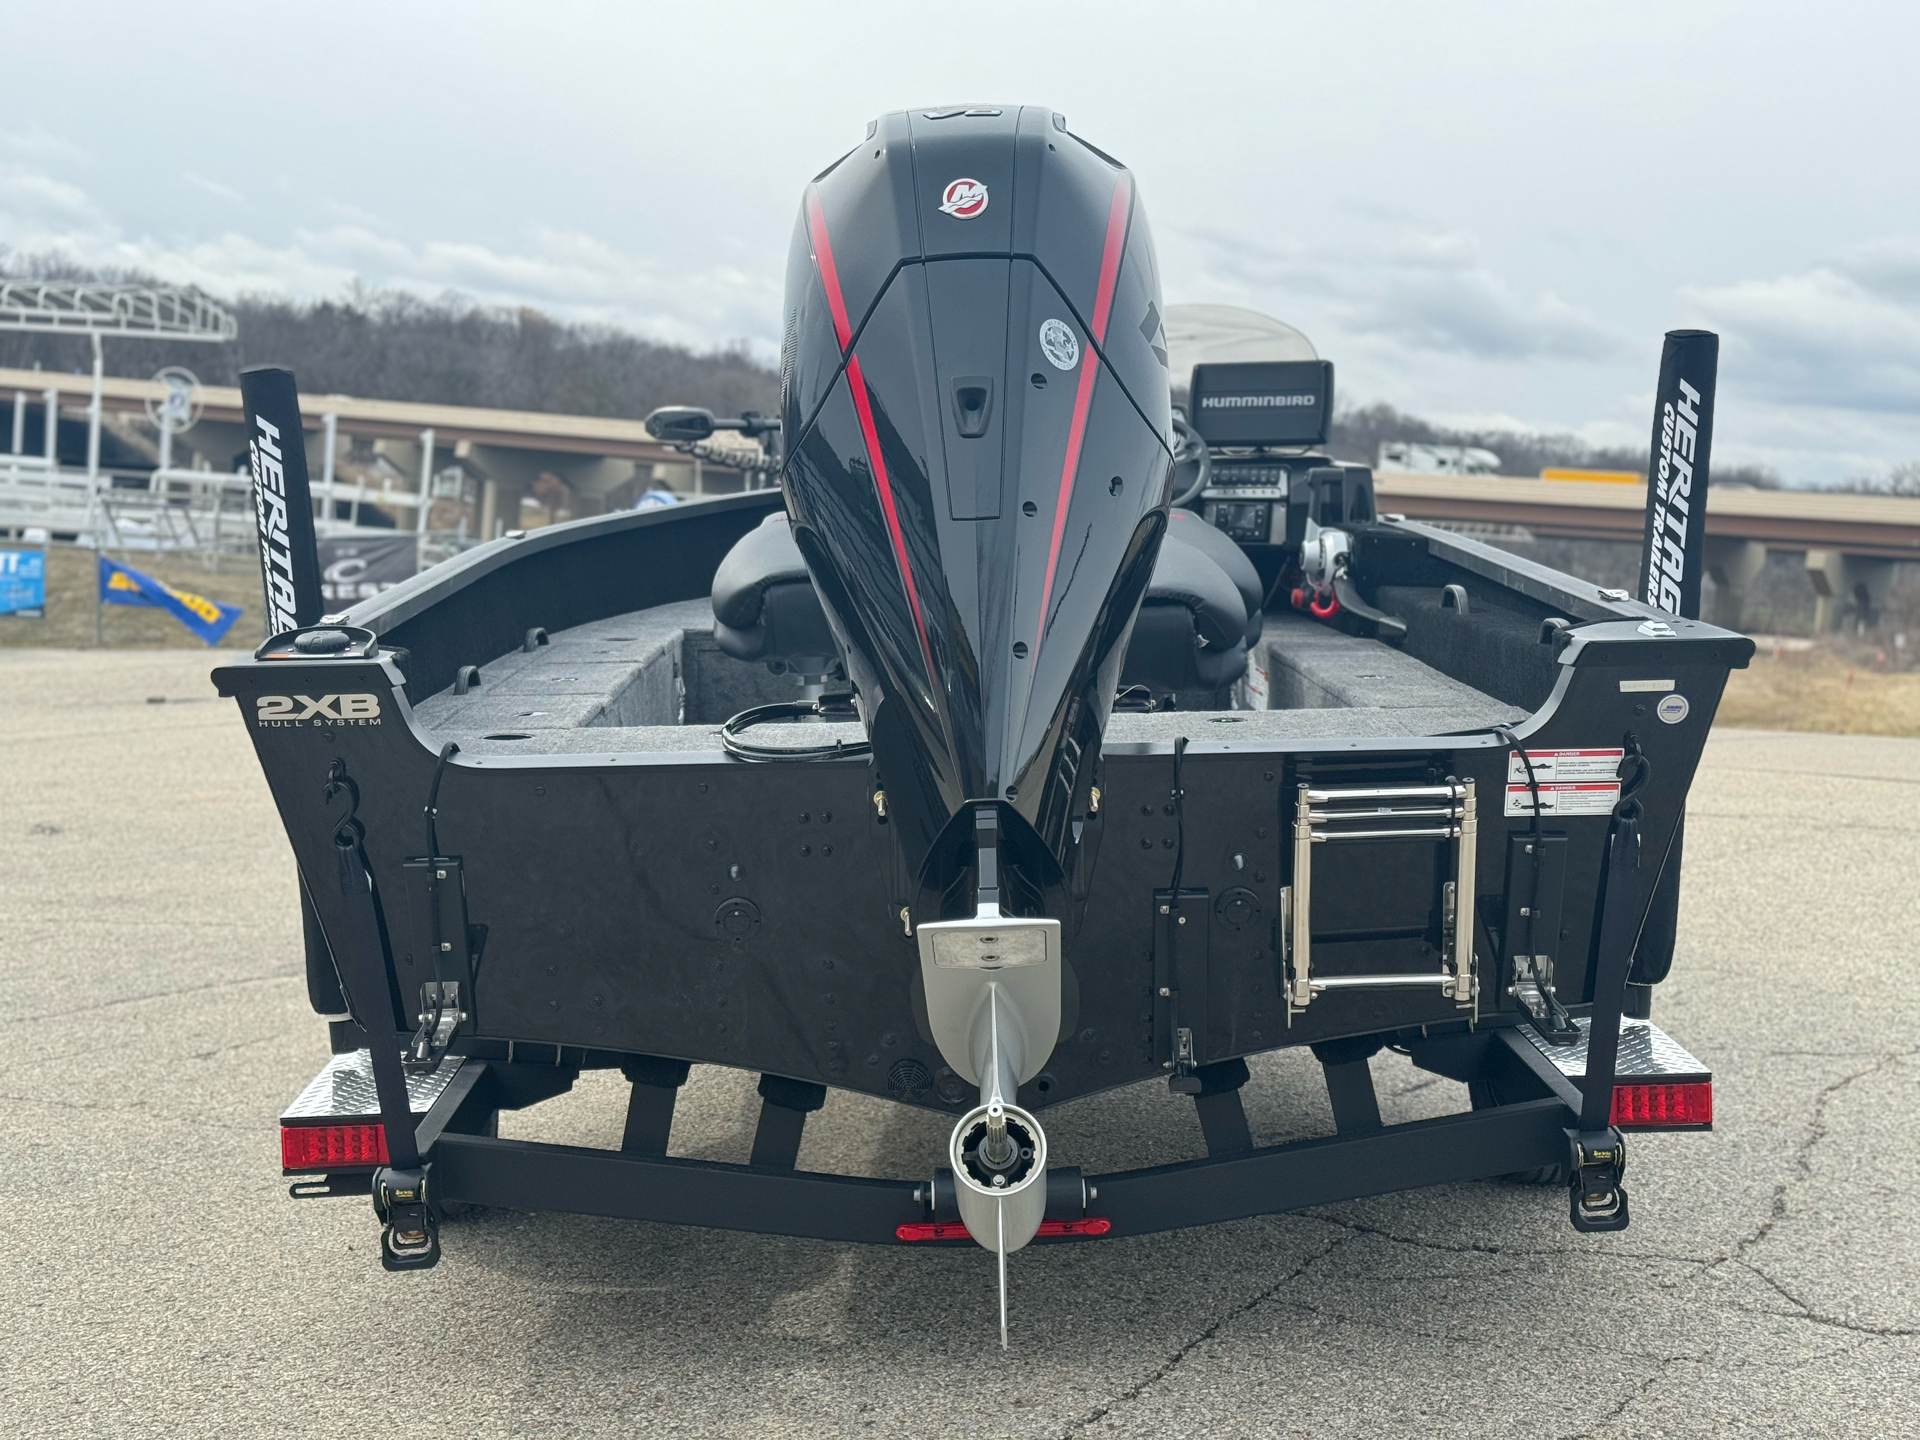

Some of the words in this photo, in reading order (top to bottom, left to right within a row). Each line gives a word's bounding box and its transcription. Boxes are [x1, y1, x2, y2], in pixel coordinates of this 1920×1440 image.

[1202, 395, 1316, 408] HUMMINBIRD
[1656, 402, 1675, 501] CUSTOM
[250, 439, 267, 536] CUSTOM
[1647, 502, 1666, 608] TRAILERS
[256, 693, 381, 720] 2XB
[258, 720, 303, 728] HULL
[313, 718, 382, 727] SYSTEM
